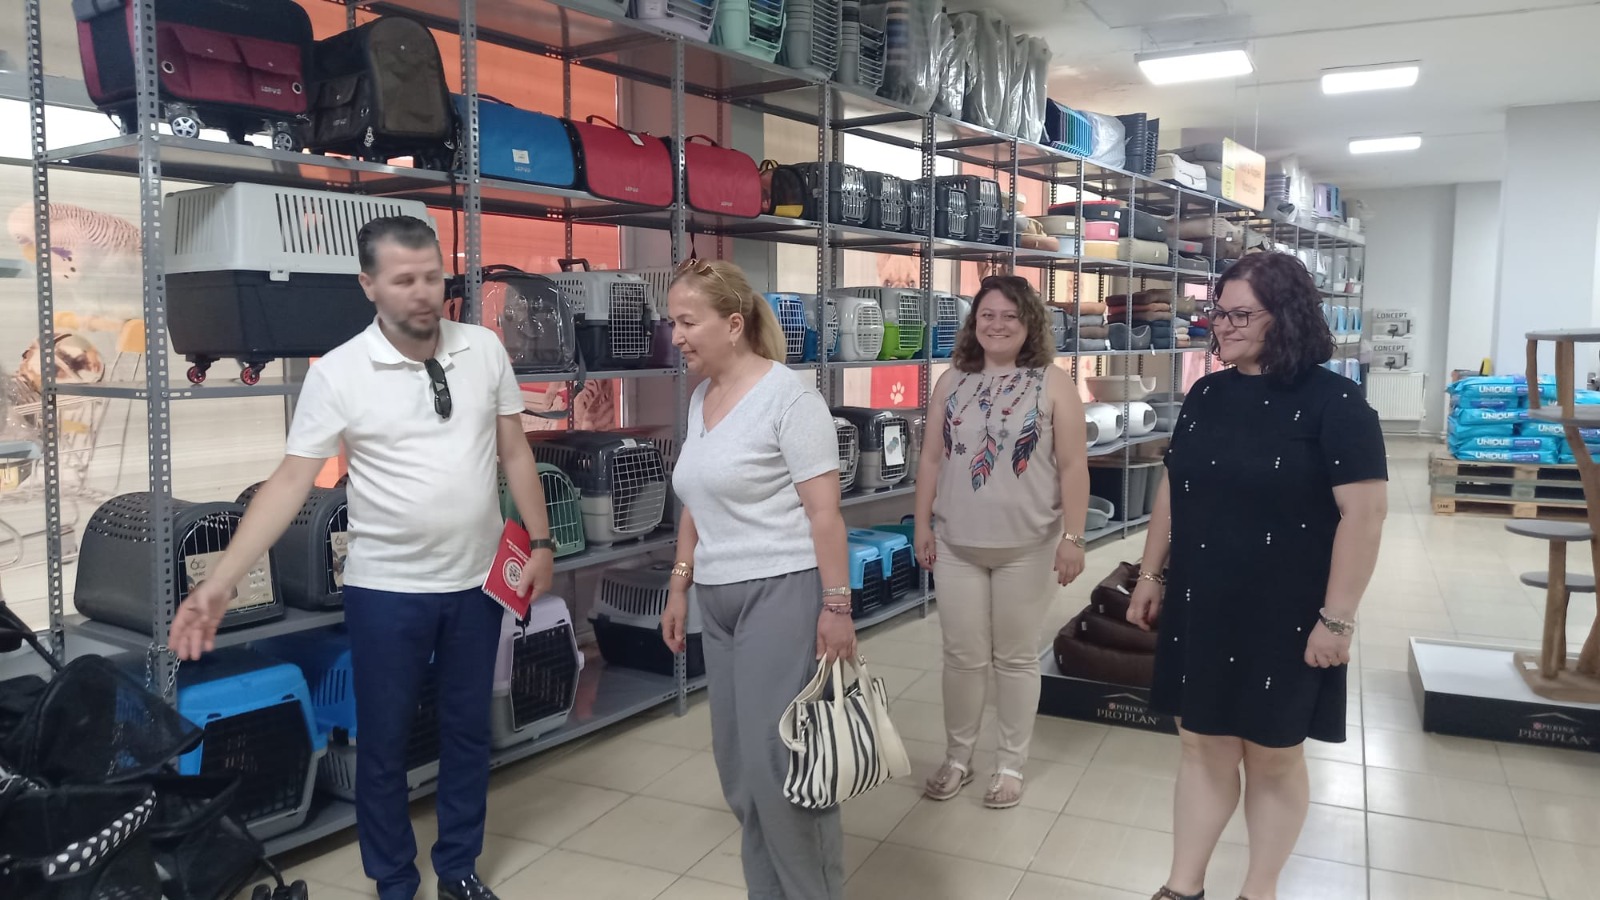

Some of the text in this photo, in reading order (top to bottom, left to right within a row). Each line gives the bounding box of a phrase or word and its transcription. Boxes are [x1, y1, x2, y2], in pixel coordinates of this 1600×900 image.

[1479, 386, 1513, 394] UNIQUE
[1481, 411, 1515, 420] UNIQUE
[1476, 438, 1510, 446] UNIQUE
[1475, 451, 1509, 460] UNIQUE
[1116, 704, 1143, 713] PURINA
[1542, 723, 1575, 733] PURINA
